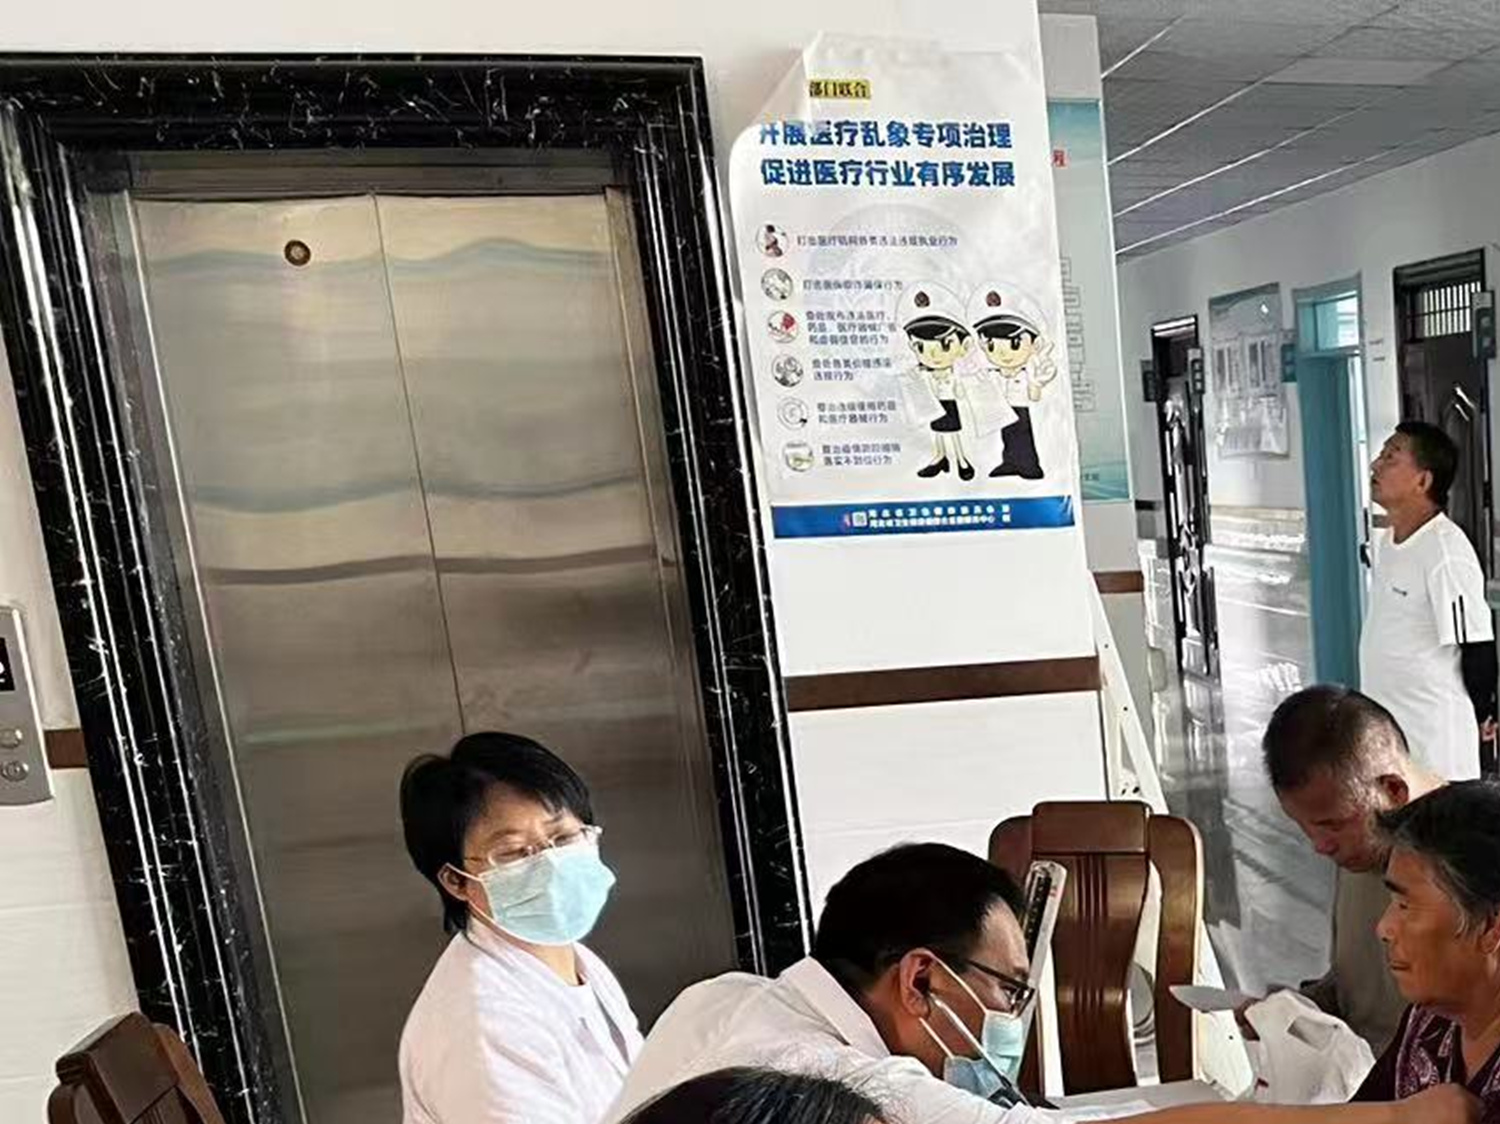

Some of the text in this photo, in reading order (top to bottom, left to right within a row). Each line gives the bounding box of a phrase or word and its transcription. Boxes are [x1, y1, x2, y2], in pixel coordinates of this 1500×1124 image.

[808, 80, 868, 98] 部门联合
[760, 119, 1013, 149] 开展医疗乱象专项治理
[761, 158, 1015, 187] 促进医疗行业有序发展
